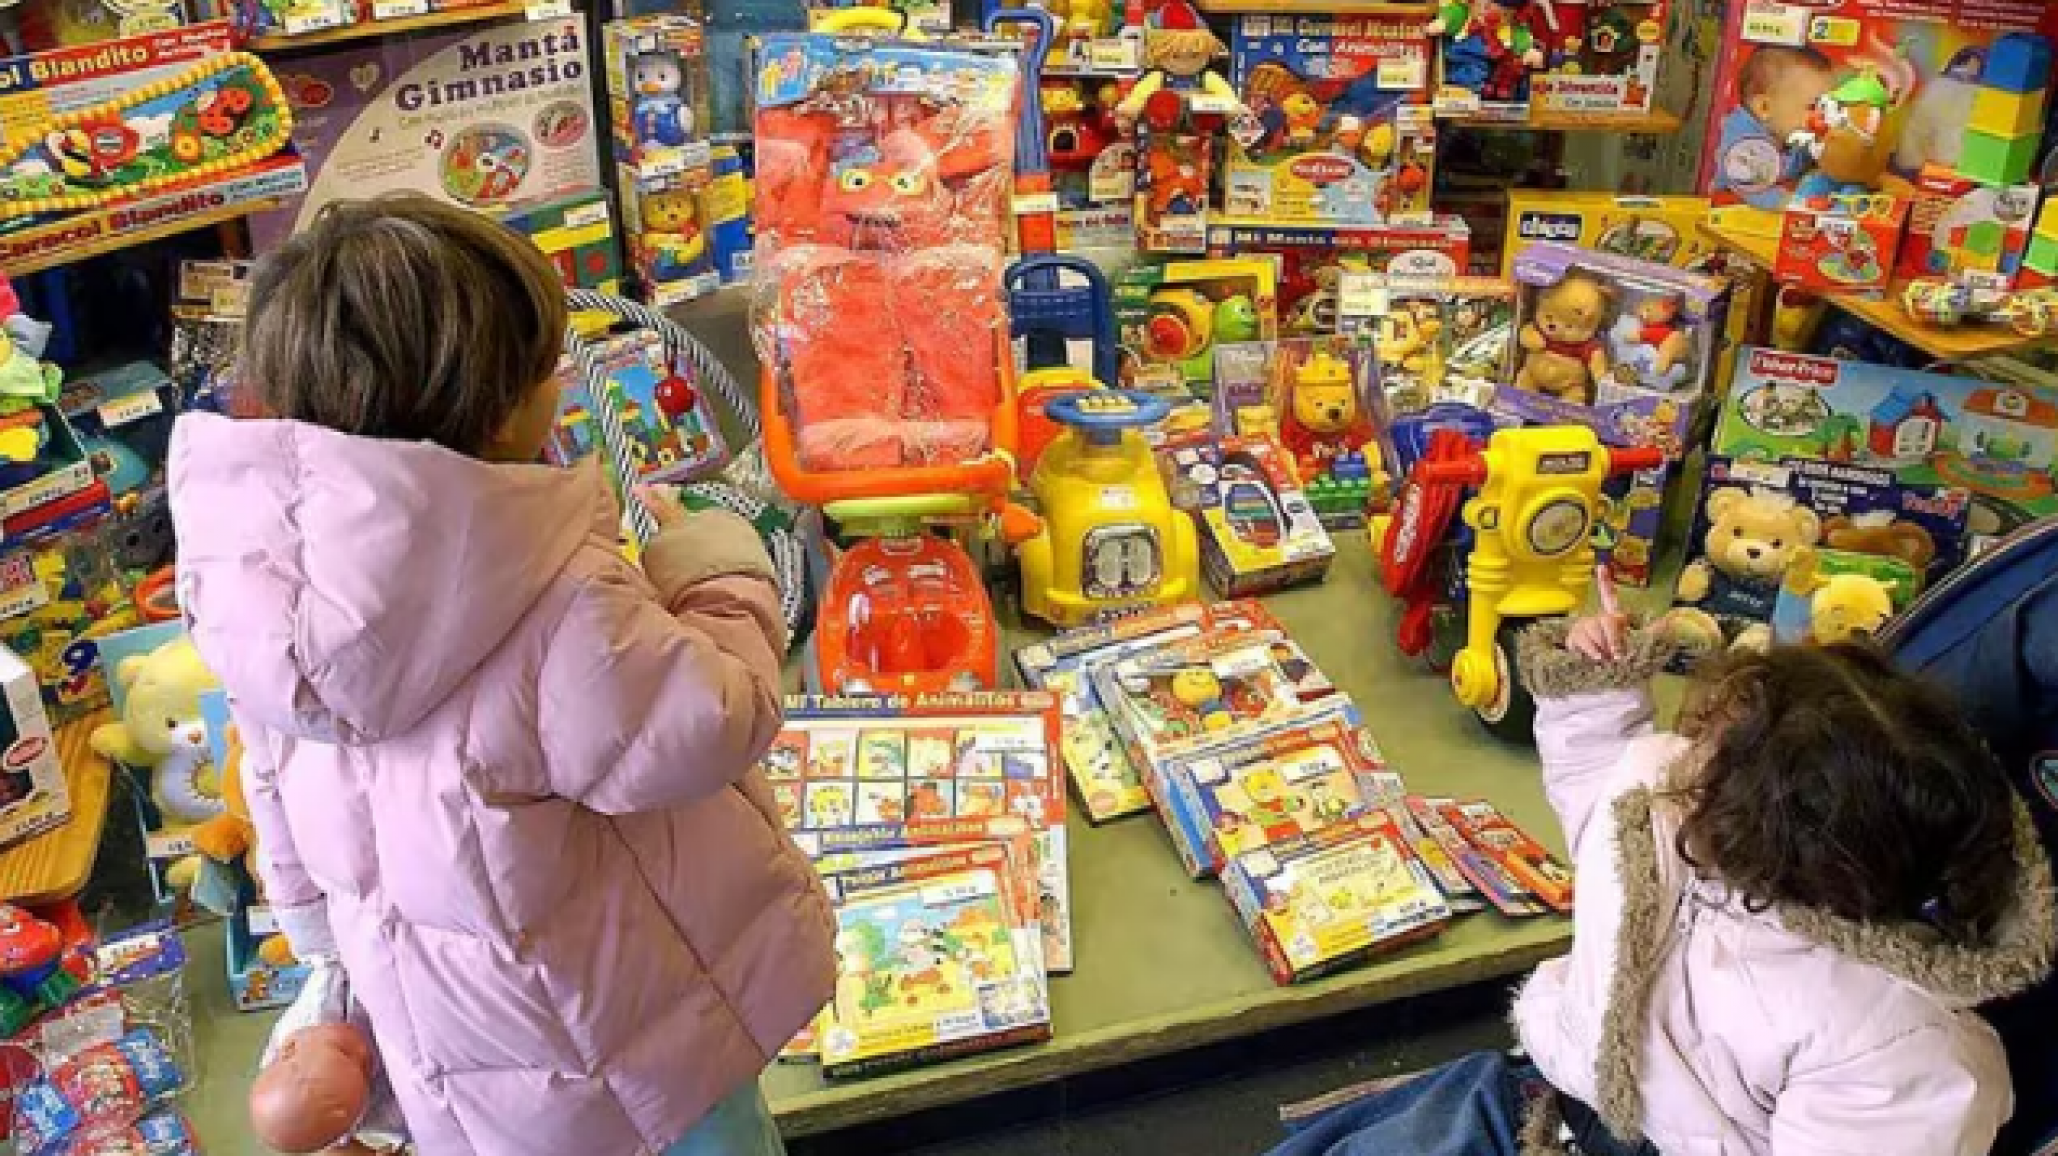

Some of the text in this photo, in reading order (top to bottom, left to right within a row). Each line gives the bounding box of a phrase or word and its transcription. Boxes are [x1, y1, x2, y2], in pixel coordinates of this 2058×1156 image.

[30, 45, 149, 82] Blandito
[396, 58, 583, 111] Gimnasio
[107, 193, 225, 230] Blandito
[813, 694, 881, 710] Tablero
[888, 694, 909, 709] de
[915, 691, 1016, 709] Animalitos
